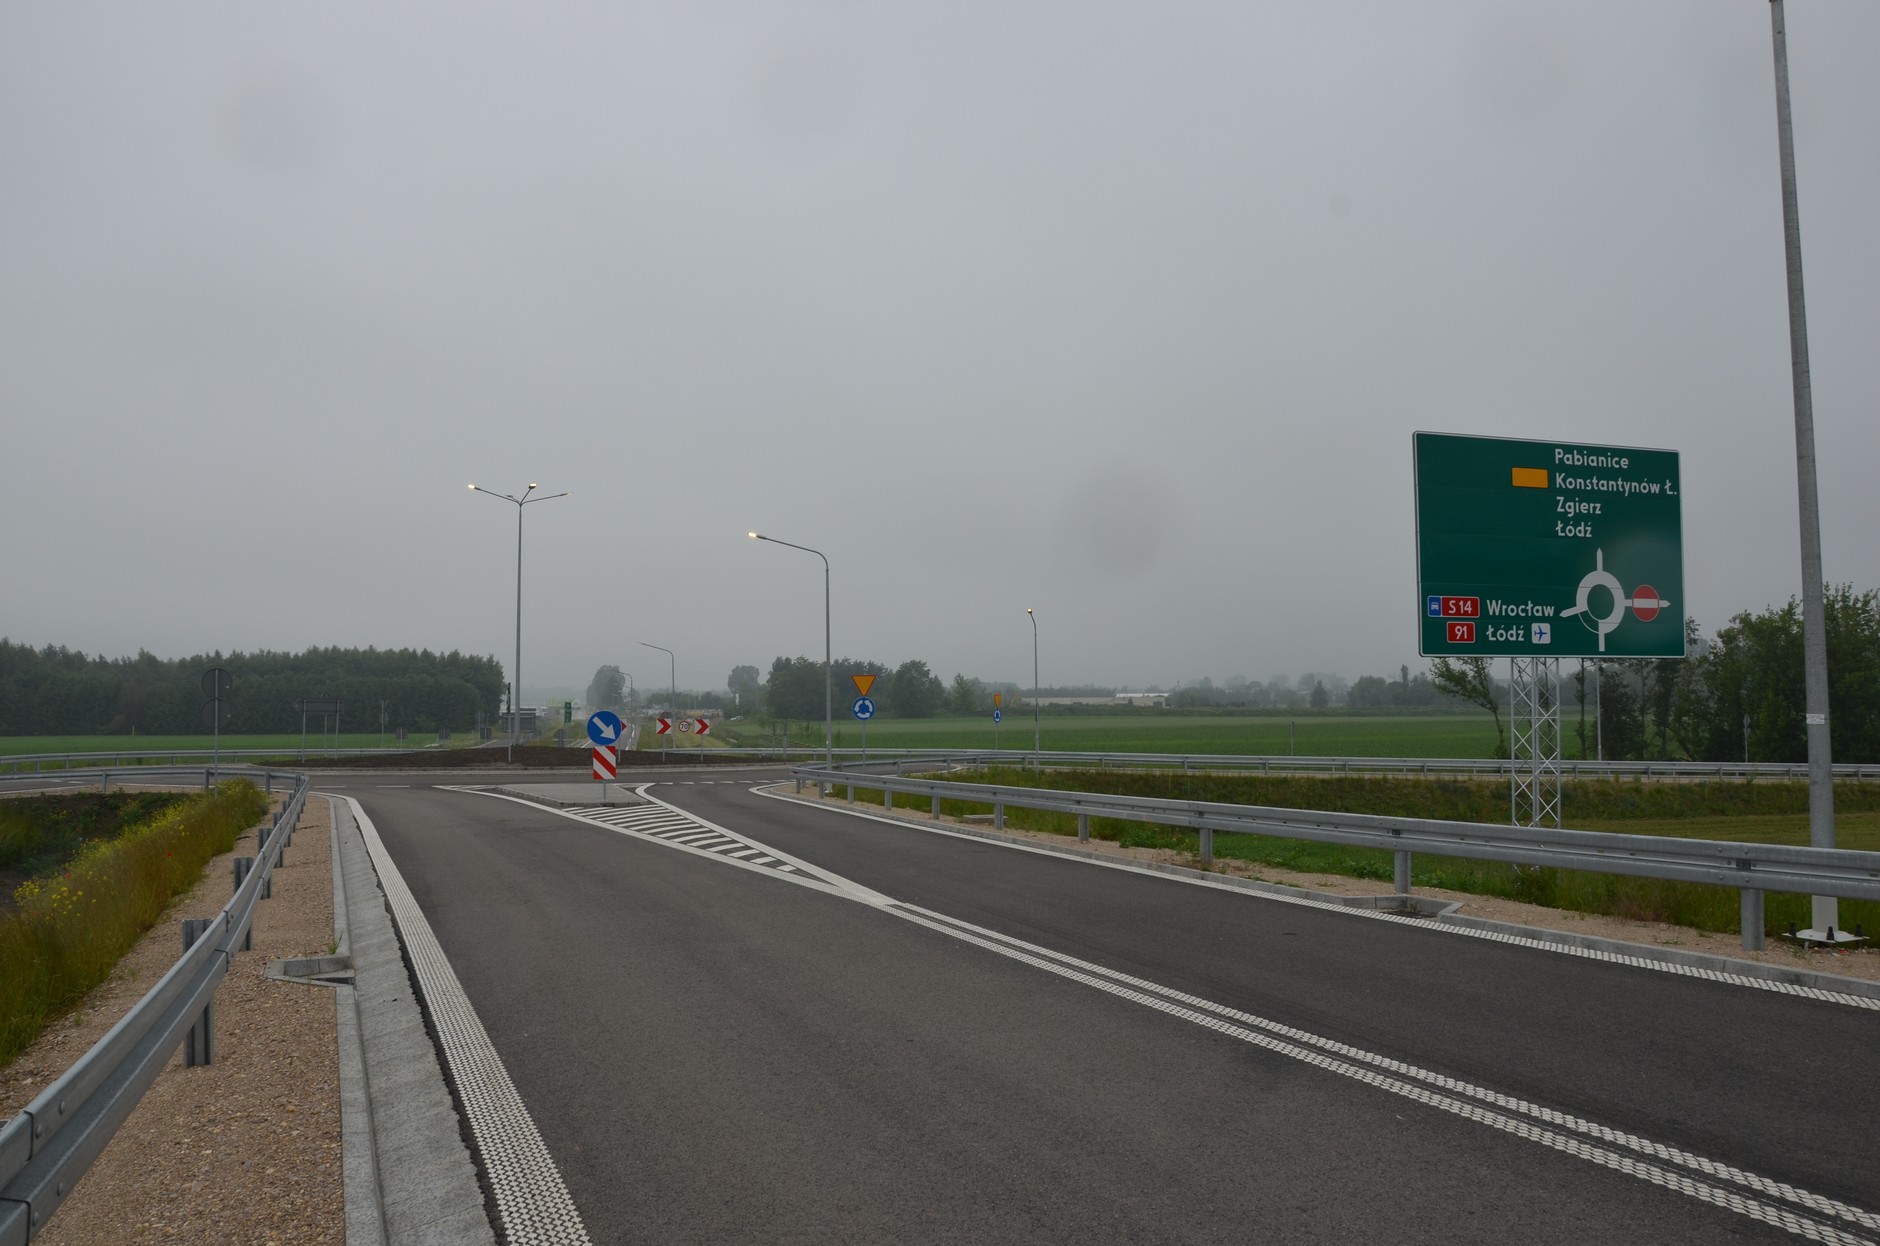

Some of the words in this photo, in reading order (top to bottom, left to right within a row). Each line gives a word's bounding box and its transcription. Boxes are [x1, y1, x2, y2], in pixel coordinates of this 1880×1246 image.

[1554, 448, 1629, 469] Pabianice
[1555, 472, 1660, 497] Konstantynów
[1663, 479, 1678, 495] Ł.
[1556, 496, 1602, 518] Zgierz
[1555, 520, 1593, 538] Łódź
[1486, 599, 1555, 617] Wrocław
[1454, 625, 1468, 640] 91
[1486, 624, 1525, 642] Łódź
